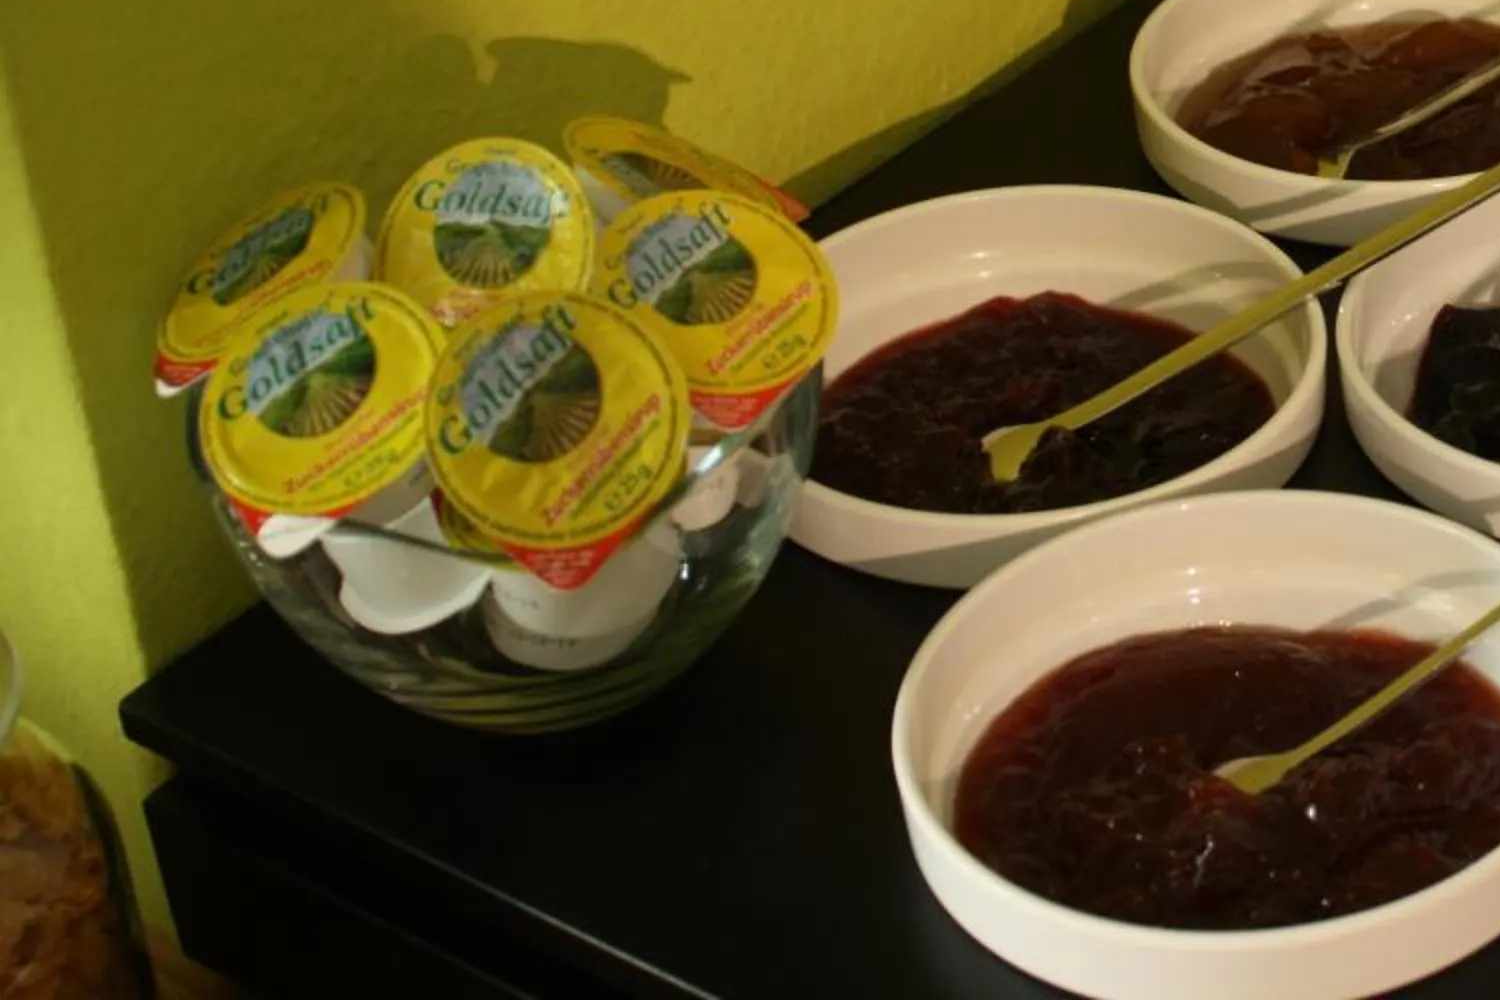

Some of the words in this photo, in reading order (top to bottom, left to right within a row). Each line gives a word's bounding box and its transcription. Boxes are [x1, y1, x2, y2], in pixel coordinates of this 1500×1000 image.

[607, 200, 731, 310] Goldsaft
[217, 296, 374, 421] Goldsaft
[439, 303, 577, 454] Goldsaft
